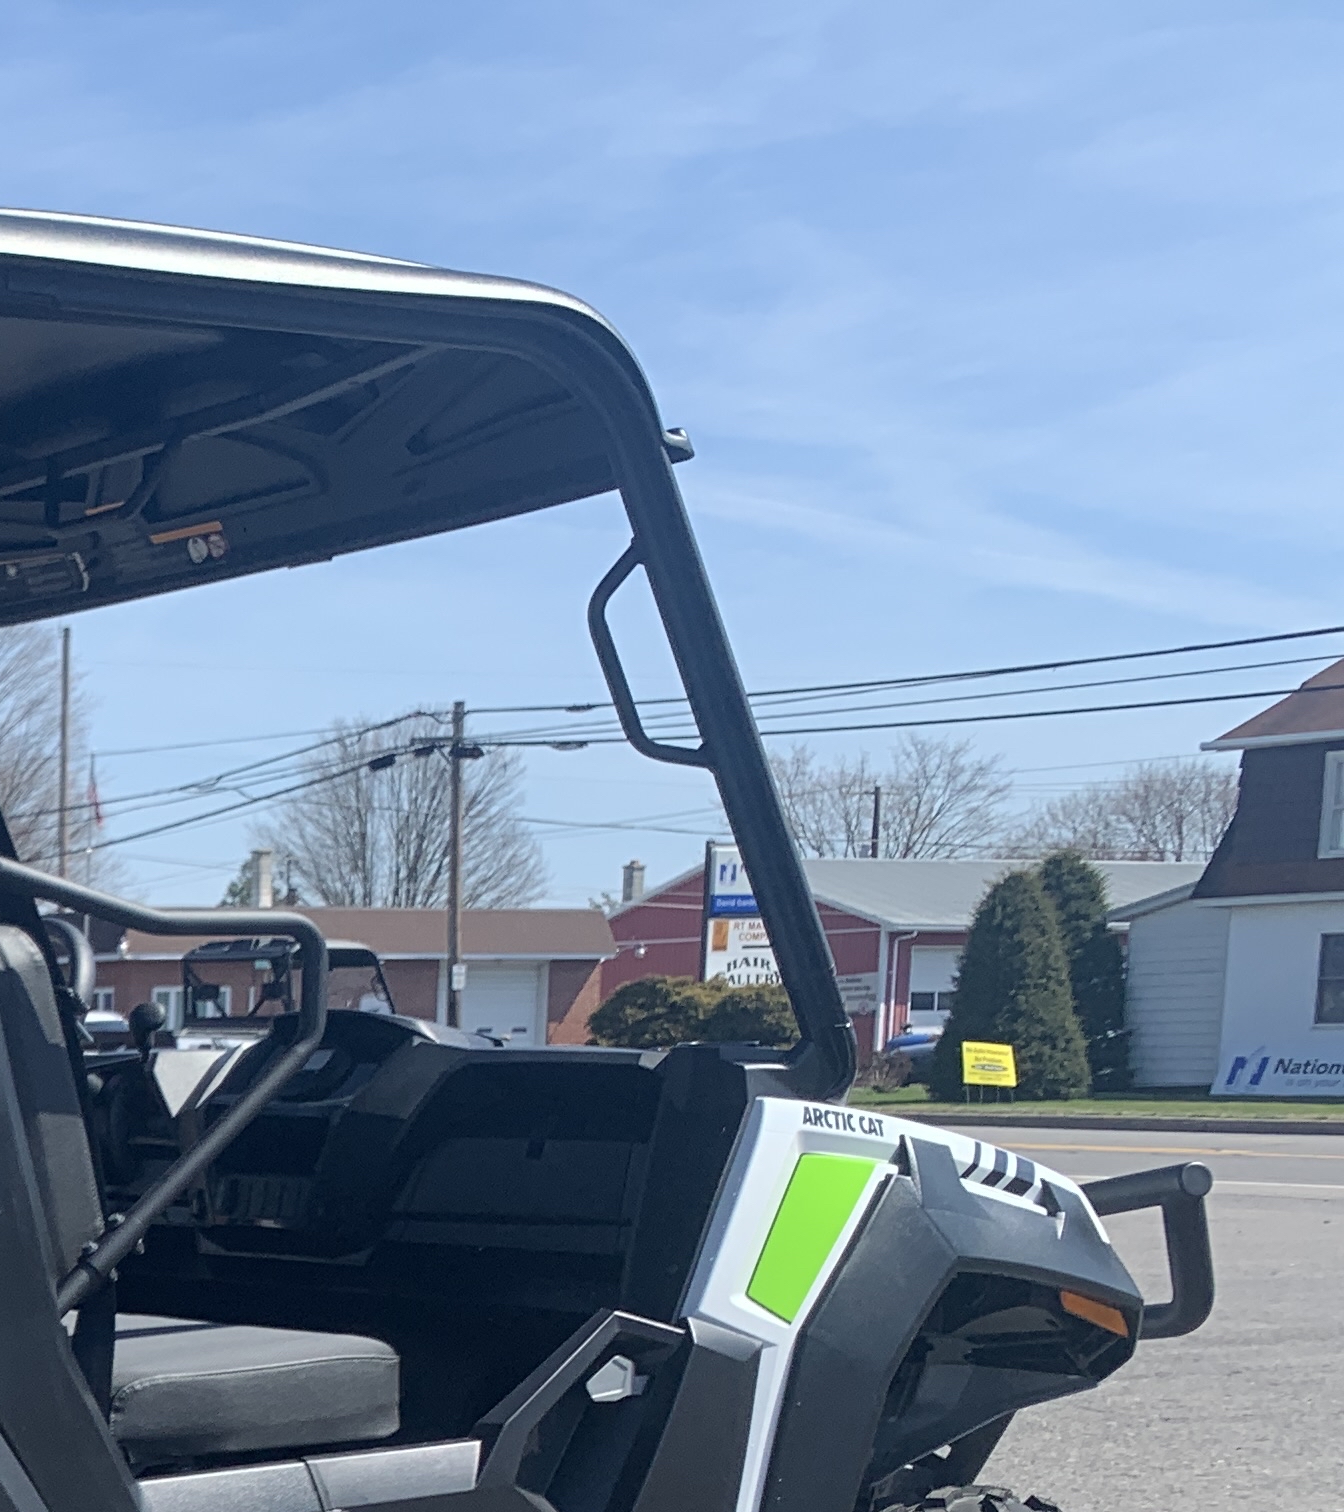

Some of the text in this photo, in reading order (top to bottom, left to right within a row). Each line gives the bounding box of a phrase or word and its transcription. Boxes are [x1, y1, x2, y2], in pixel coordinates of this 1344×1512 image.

[733, 921, 763, 931] RT MA
[726, 956, 772, 972] HAIR
[716, 971, 781, 986] ALLERY
[1273, 1058, 1344, 1075] Nation
[802, 1106, 884, 1137] ARCTIC CAT
